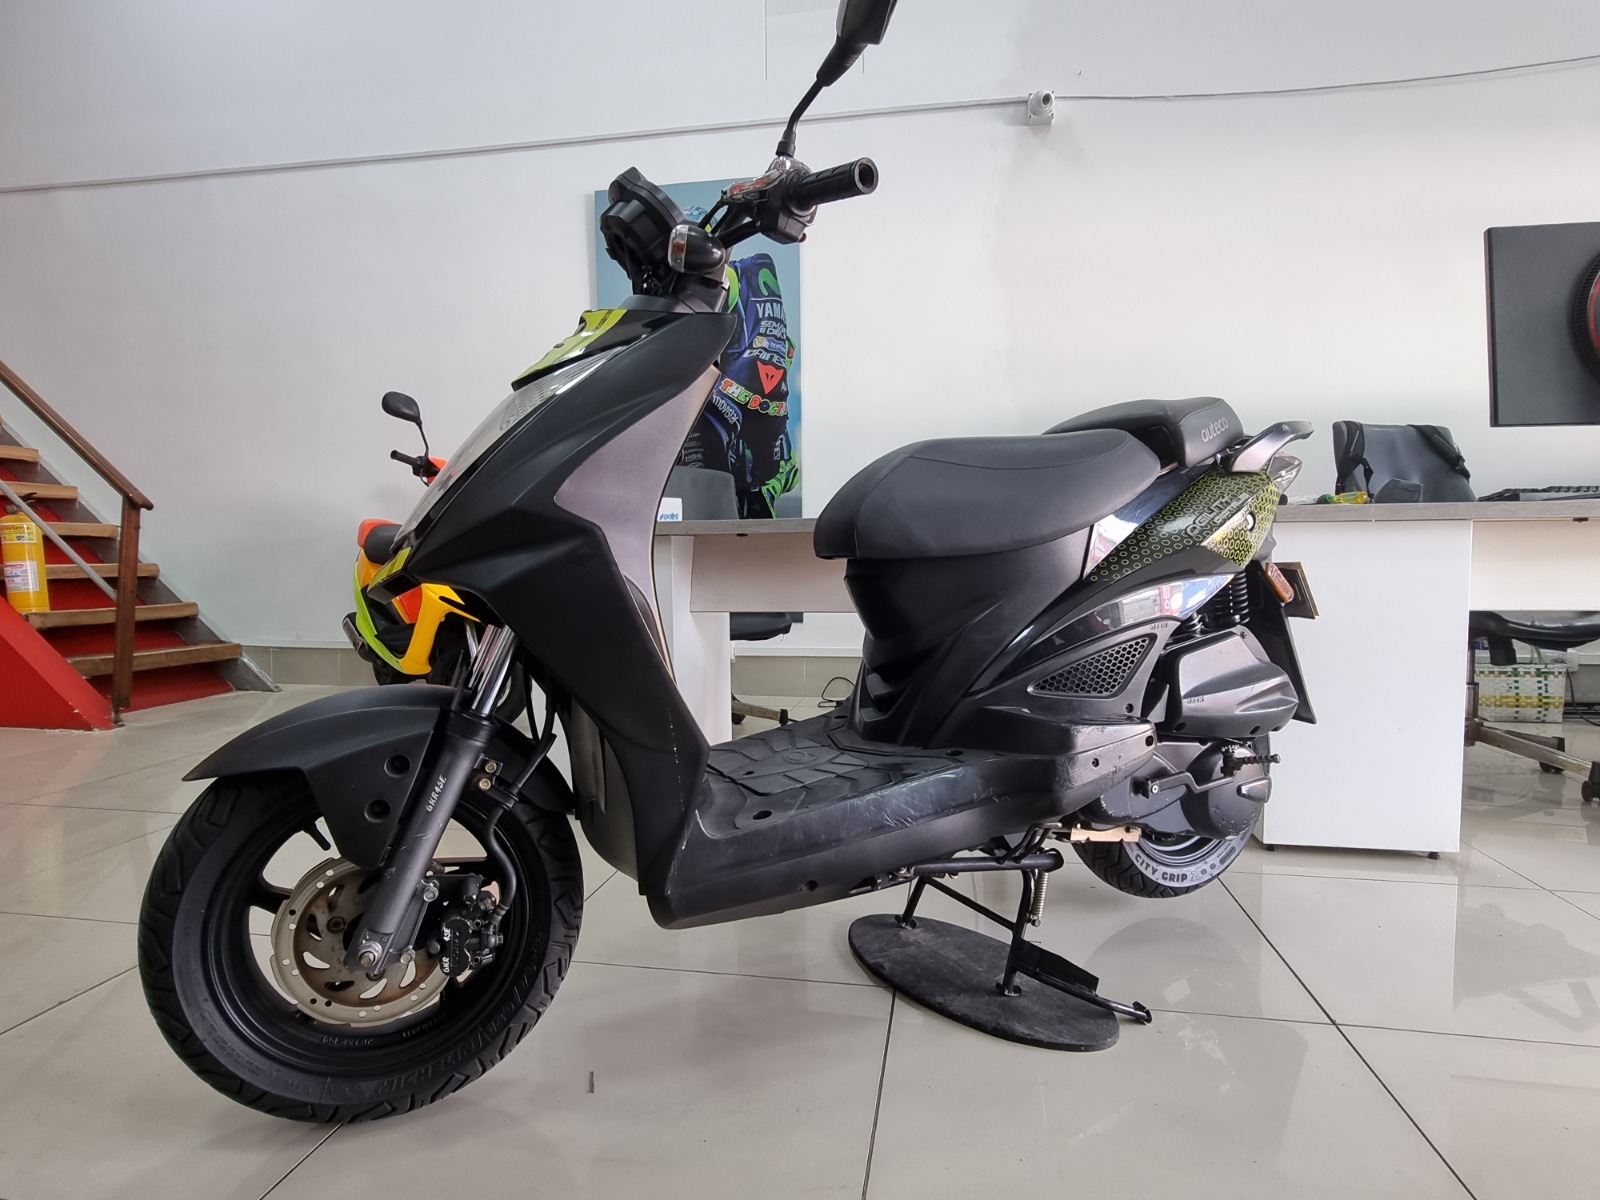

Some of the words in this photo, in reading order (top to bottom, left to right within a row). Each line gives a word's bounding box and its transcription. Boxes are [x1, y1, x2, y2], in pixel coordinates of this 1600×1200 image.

[719, 378, 753, 404] THE
[1201, 416, 1229, 443] auteco
[1185, 494, 1231, 537] AGILITY
[1134, 852, 1159, 876] CITY
[1161, 871, 1188, 883] GRIP
